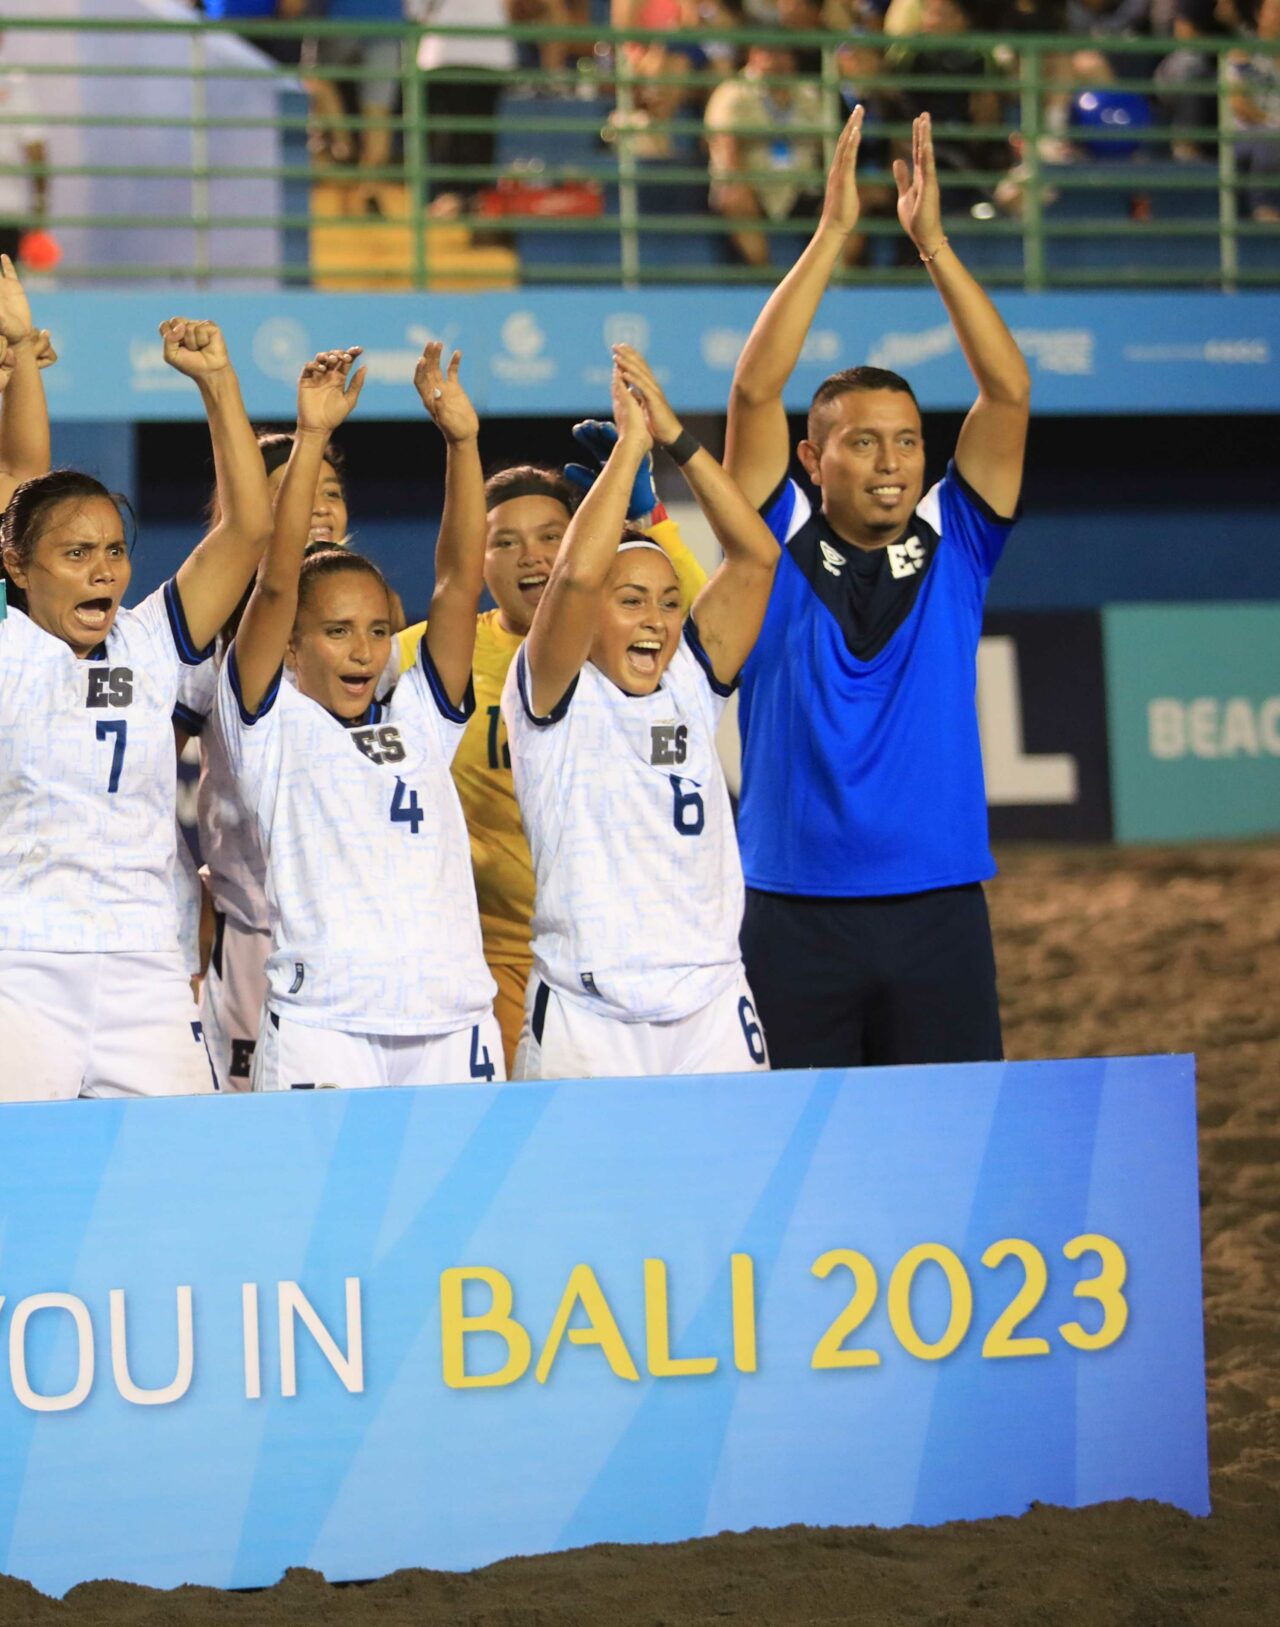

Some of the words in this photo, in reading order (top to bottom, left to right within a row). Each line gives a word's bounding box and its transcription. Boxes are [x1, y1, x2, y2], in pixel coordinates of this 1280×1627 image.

[886, 535, 925, 579] ES
[86, 667, 133, 708] ES
[96, 720, 127, 793] 7
[350, 726, 407, 766] ES
[650, 724, 688, 765] ES
[1146, 696, 1280, 760] BEAC
[390, 775, 424, 834] 4
[669, 773, 705, 836] 6
[470, 1024, 496, 1082] 4
[737, 995, 766, 1065] 6
[241, 1275, 366, 1400] IN
[440, 1252, 758, 1389] BALI
[810, 1234, 1130, 1370] 2023
